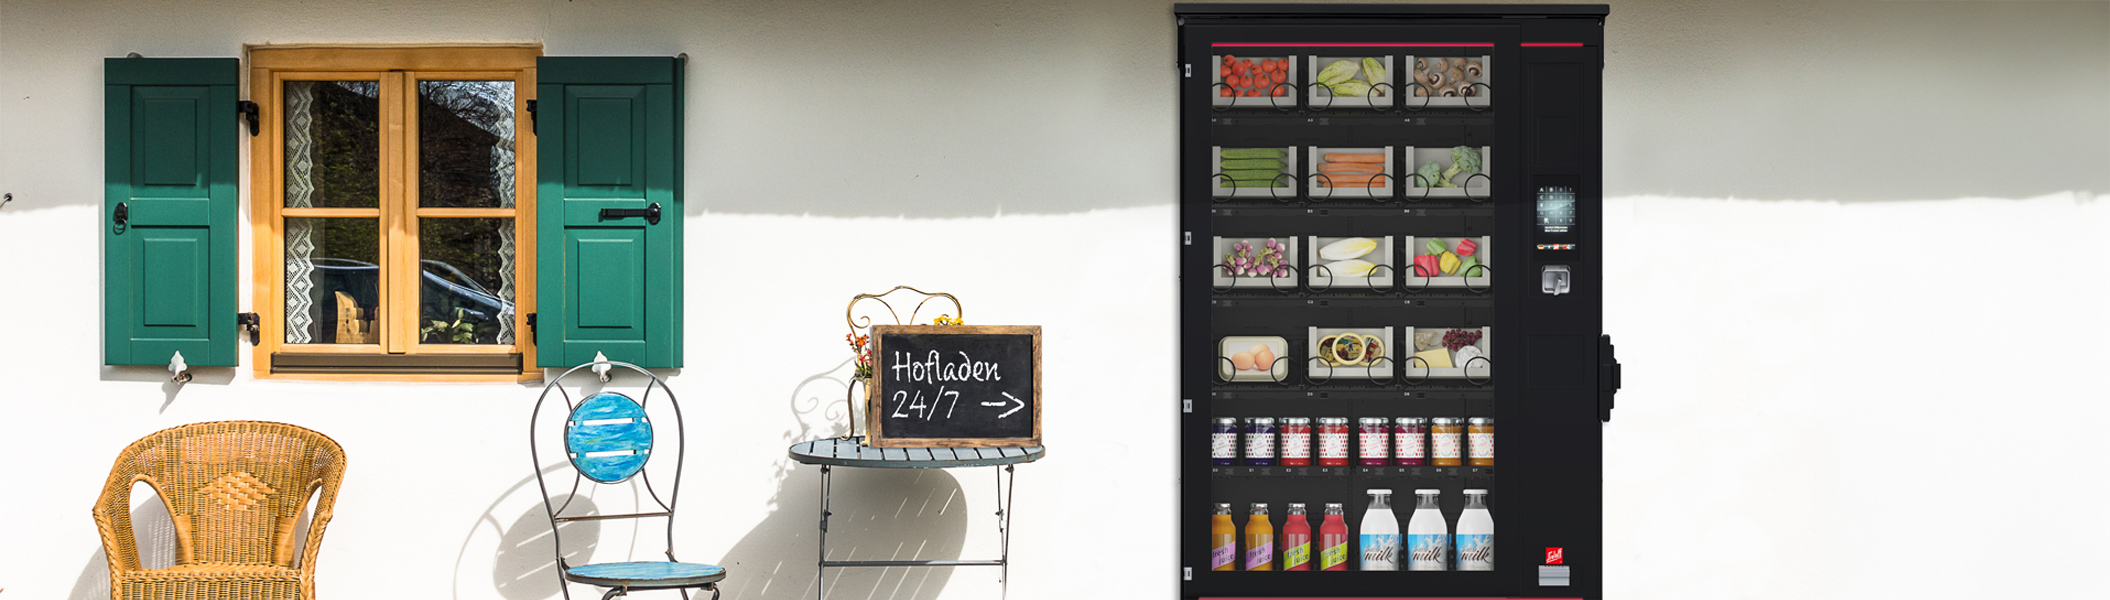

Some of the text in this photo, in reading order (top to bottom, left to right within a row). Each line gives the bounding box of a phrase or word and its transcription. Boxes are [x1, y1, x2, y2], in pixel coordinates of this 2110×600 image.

[892, 350, 1001, 384] Hofladen
[892, 386, 960, 420] 24/7
[1212, 547, 1228, 558] fresh
[1249, 547, 1266, 558] fresh
[1288, 547, 1303, 558] fresh
[1324, 547, 1340, 558] fresh
[1364, 546, 1394, 563] milk
[1413, 546, 1442, 563] milk
[1461, 546, 1490, 563] milk
[1218, 554, 1234, 565] juice
[1256, 554, 1270, 565] juice
[1294, 554, 1308, 565] juice
[1330, 554, 1345, 565] juice
